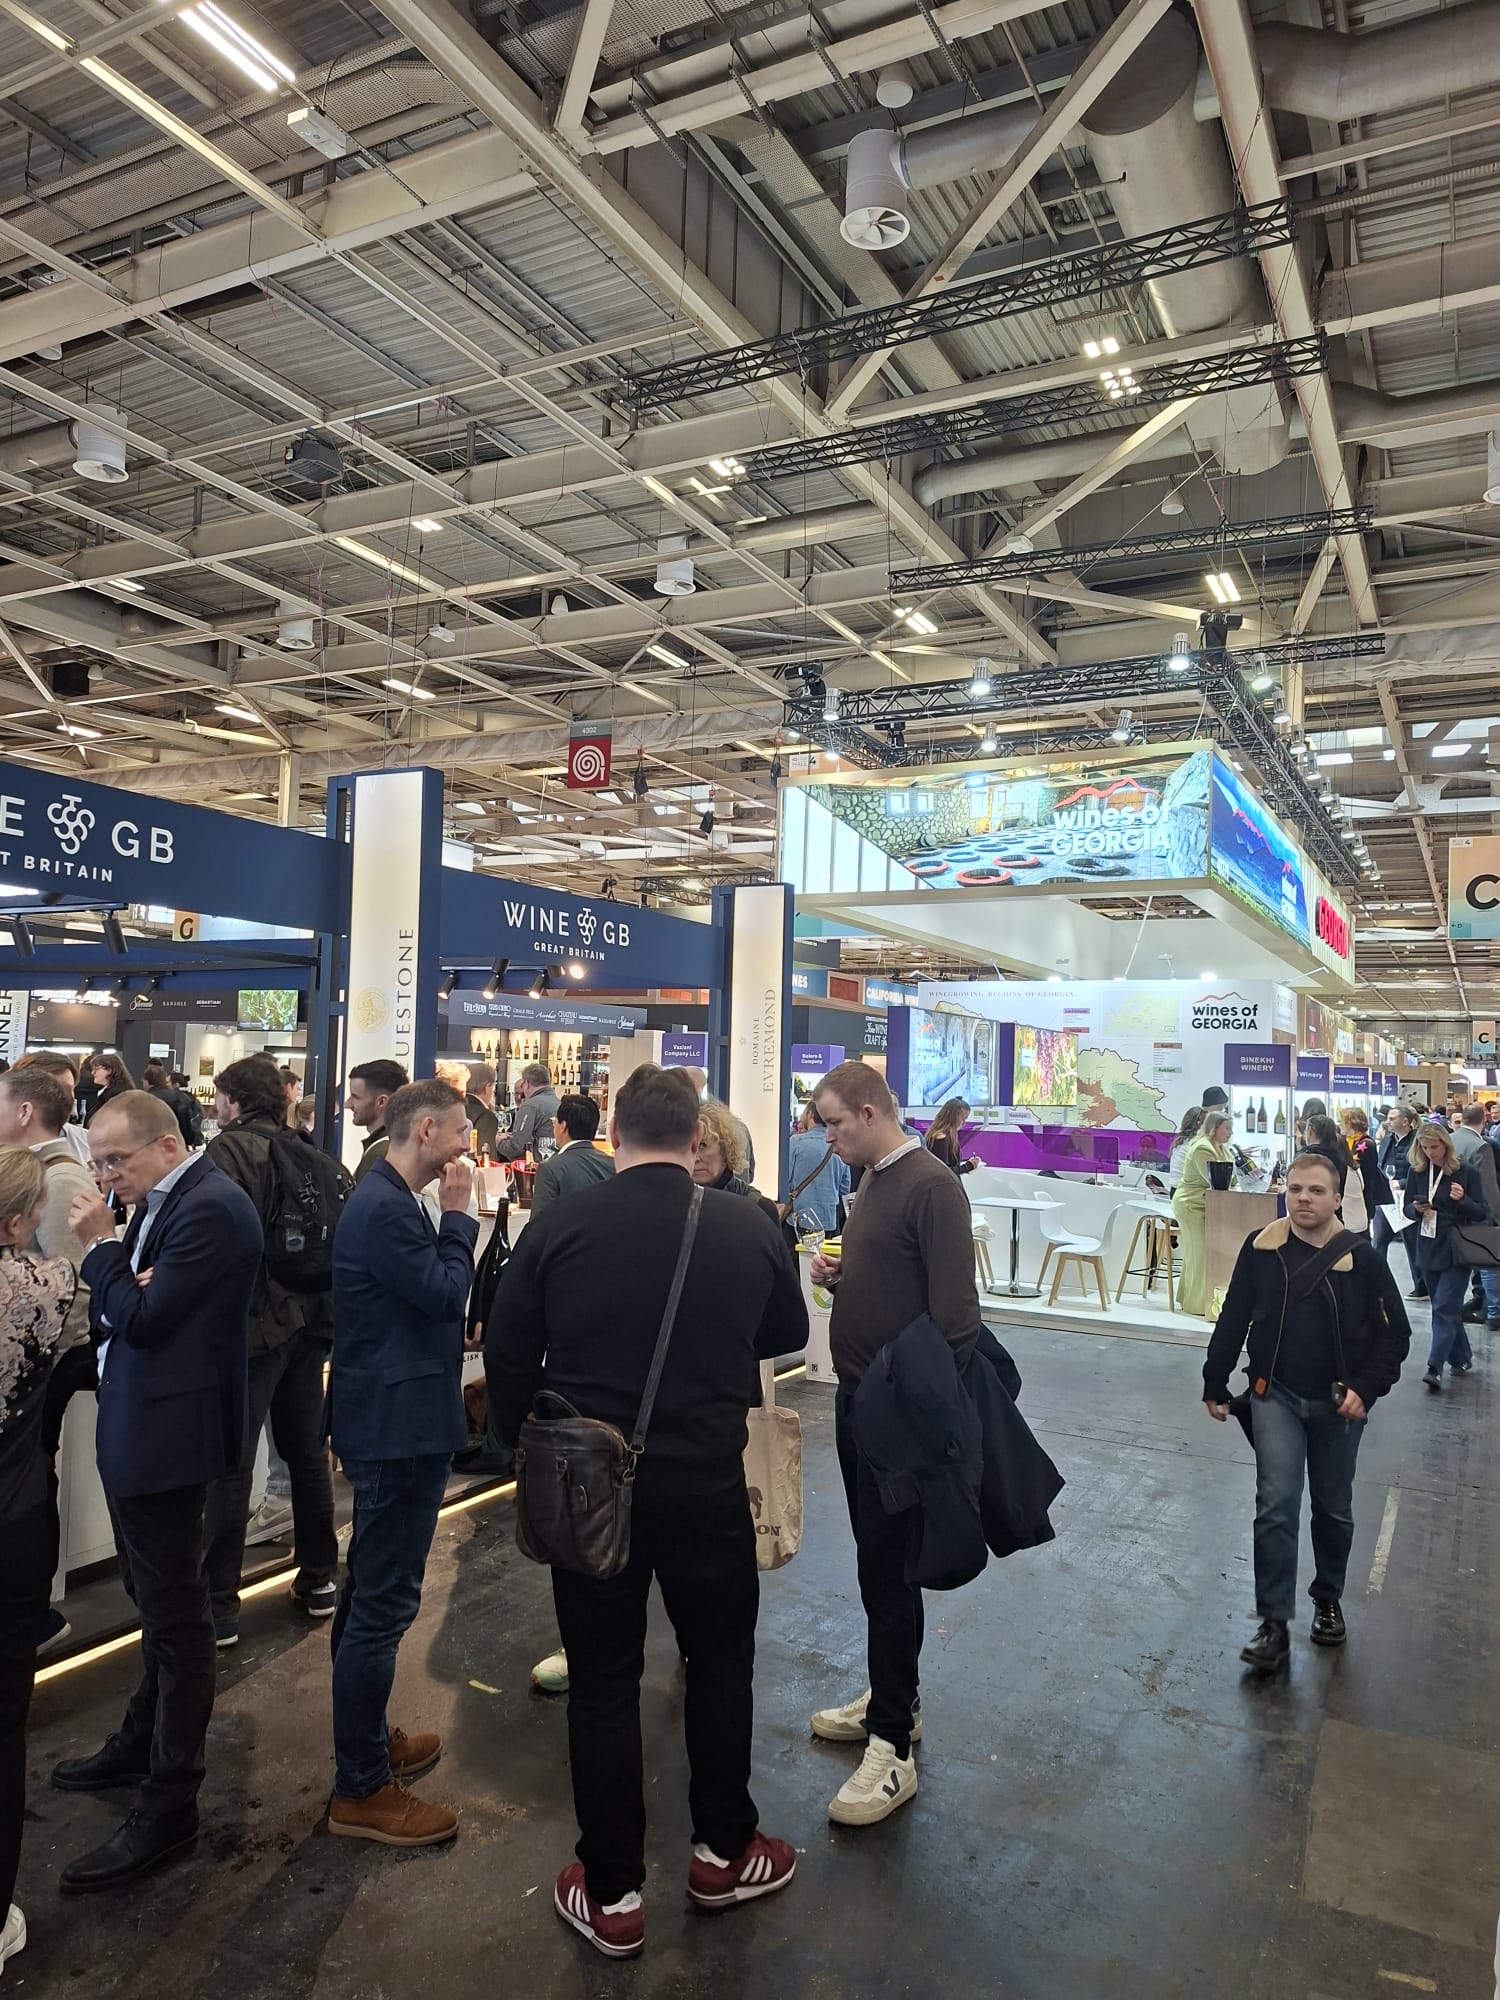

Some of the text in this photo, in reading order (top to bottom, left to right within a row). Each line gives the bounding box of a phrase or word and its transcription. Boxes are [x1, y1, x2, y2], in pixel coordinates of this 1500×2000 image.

[1053, 799, 1171, 830] wines of
[111, 820, 174, 864] GB
[1051, 828, 1172, 856] GEORGIA
[23, 855, 113, 883] BRITAIN
[1465, 873, 1500, 910] C
[179, 917, 194, 940] G
[503, 900, 630, 947] WINE GB
[1316, 895, 1349, 960] GEORGIA
[534, 941, 606, 961] GREAT BRITAIN
[866, 986, 904, 1004] CALIFORNIA
[1192, 1003, 1259, 1017] wines of
[1191, 1017, 1258, 1031] GEORGIA
[752, 1017, 760, 1065] DOMAINE
[762, 989, 776, 1093] EVREMOND
[1478, 1032, 1489, 1044] C
[664, 1050, 689, 1058] Company
[1240, 1056, 1275, 1064] BINEKHI
[1240, 1064, 1274, 1072] WINERY
[1299, 1071, 1323, 1079] Winery
[756, 1524, 782, 1537] ON
